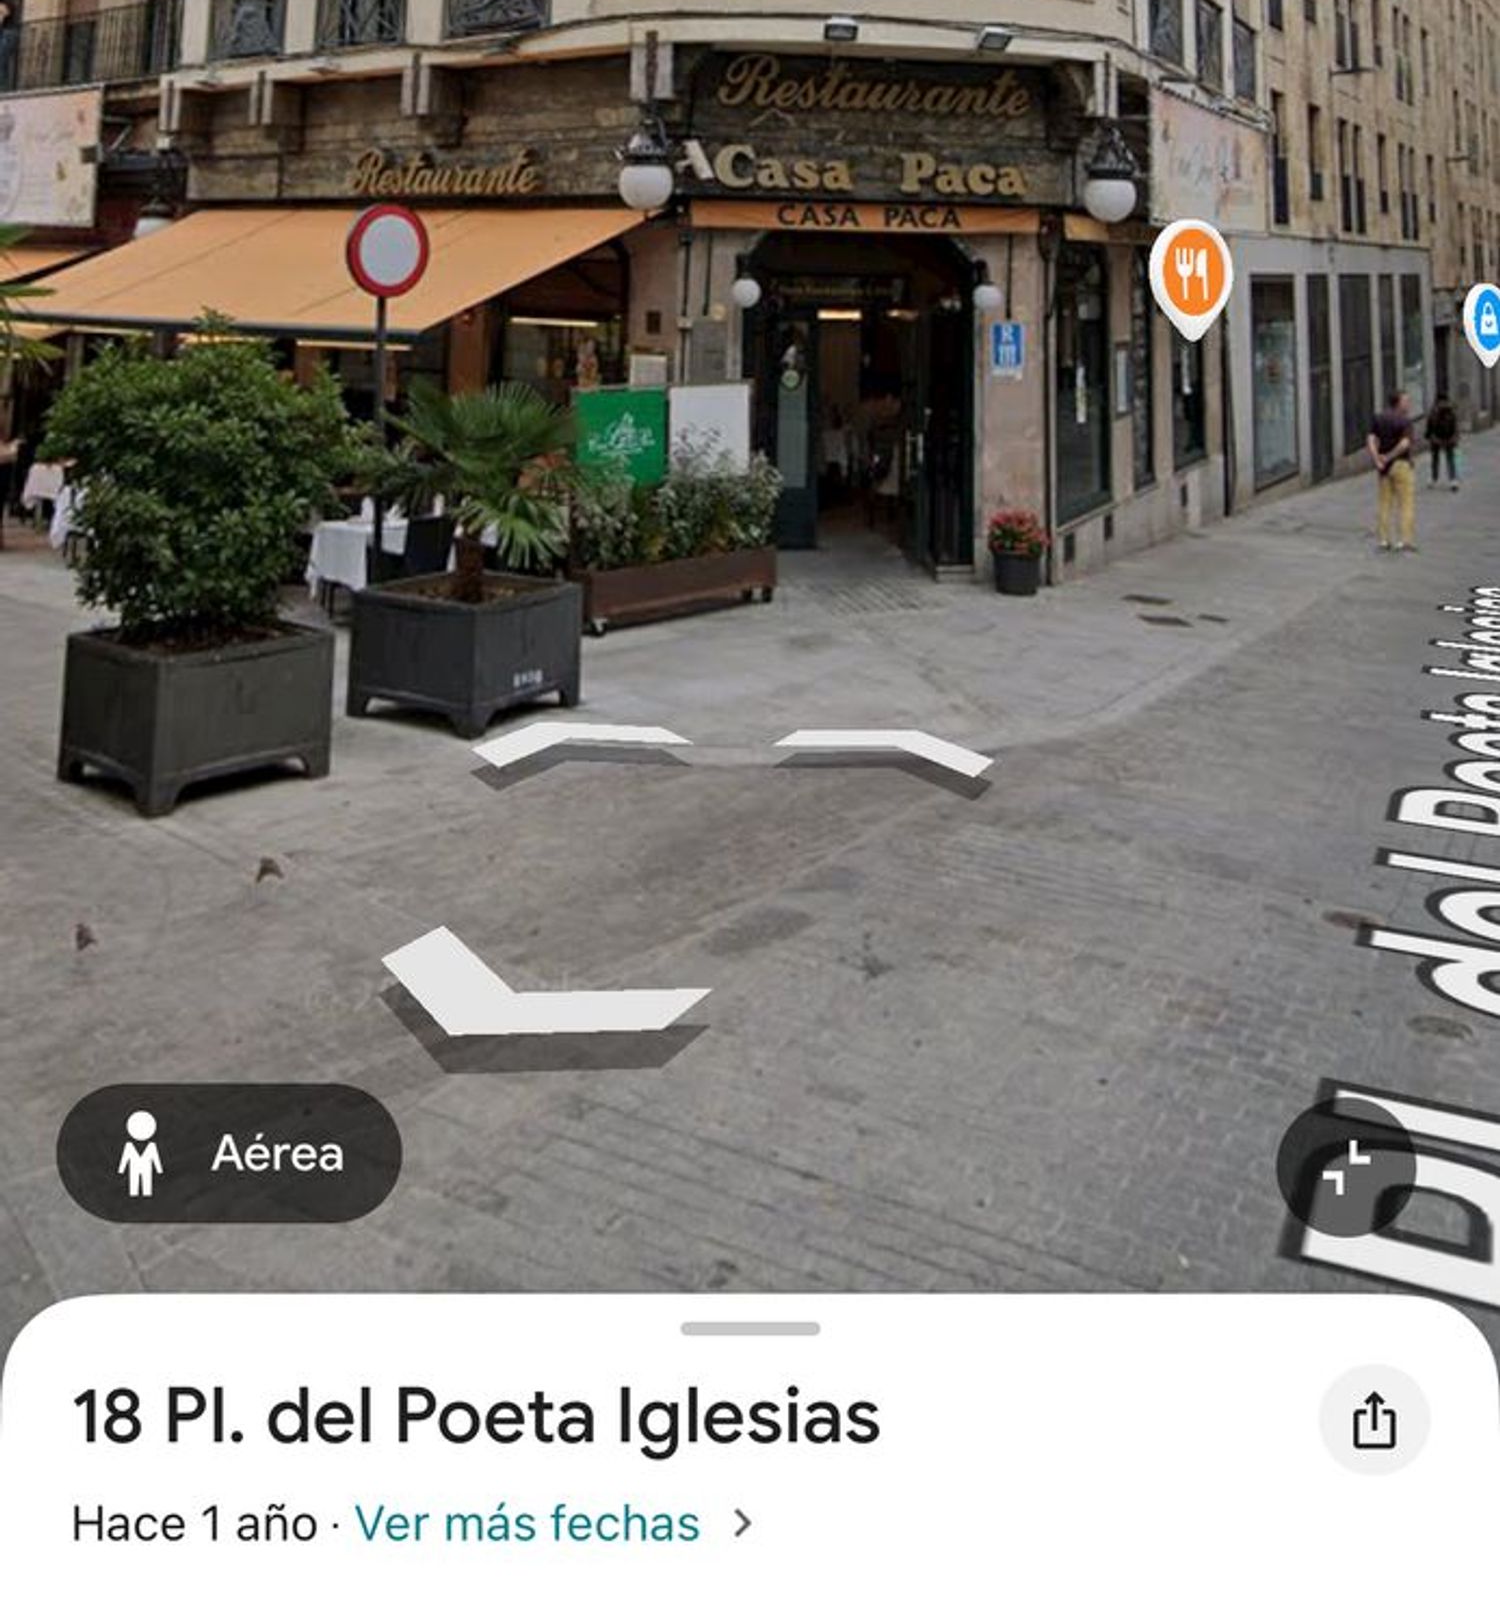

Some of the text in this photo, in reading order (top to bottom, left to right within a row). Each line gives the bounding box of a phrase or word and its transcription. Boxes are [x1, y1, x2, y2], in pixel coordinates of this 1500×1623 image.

[717, 54, 1031, 118] Restaurante
[348, 148, 544, 195] Restaurante
[714, 144, 1027, 195] Casa Paca
[777, 204, 963, 229] CASA PACA
